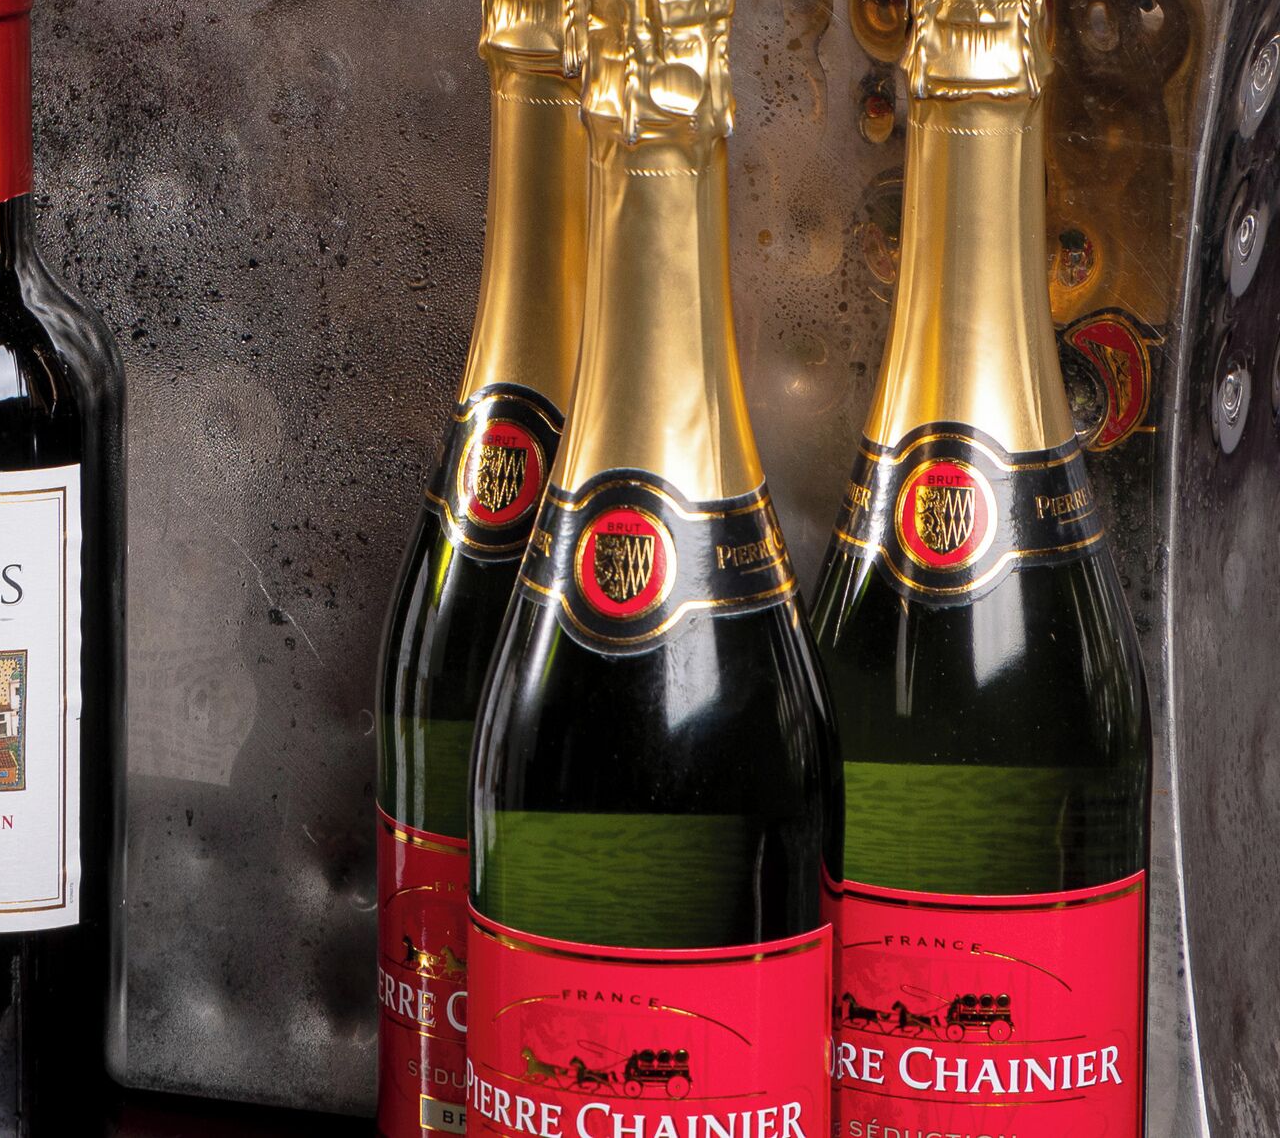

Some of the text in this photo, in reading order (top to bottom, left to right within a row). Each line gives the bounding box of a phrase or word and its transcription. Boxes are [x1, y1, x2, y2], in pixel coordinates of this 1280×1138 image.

[487, 434, 518, 447] BRUT
[927, 474, 962, 485] BRUT
[1034, 486, 1089, 519] PIERRE
[607, 521, 642, 533] BRUT
[715, 536, 776, 570] PIERRE
[884, 935, 982, 955] FRANCE
[377, 966, 436, 1028] ERRE
[561, 989, 662, 1009] FRANCE
[898, 1045, 1122, 1096] CHAINIER
[466, 1058, 562, 1138] PIERRE
[576, 1101, 807, 1138] CHAINIER
